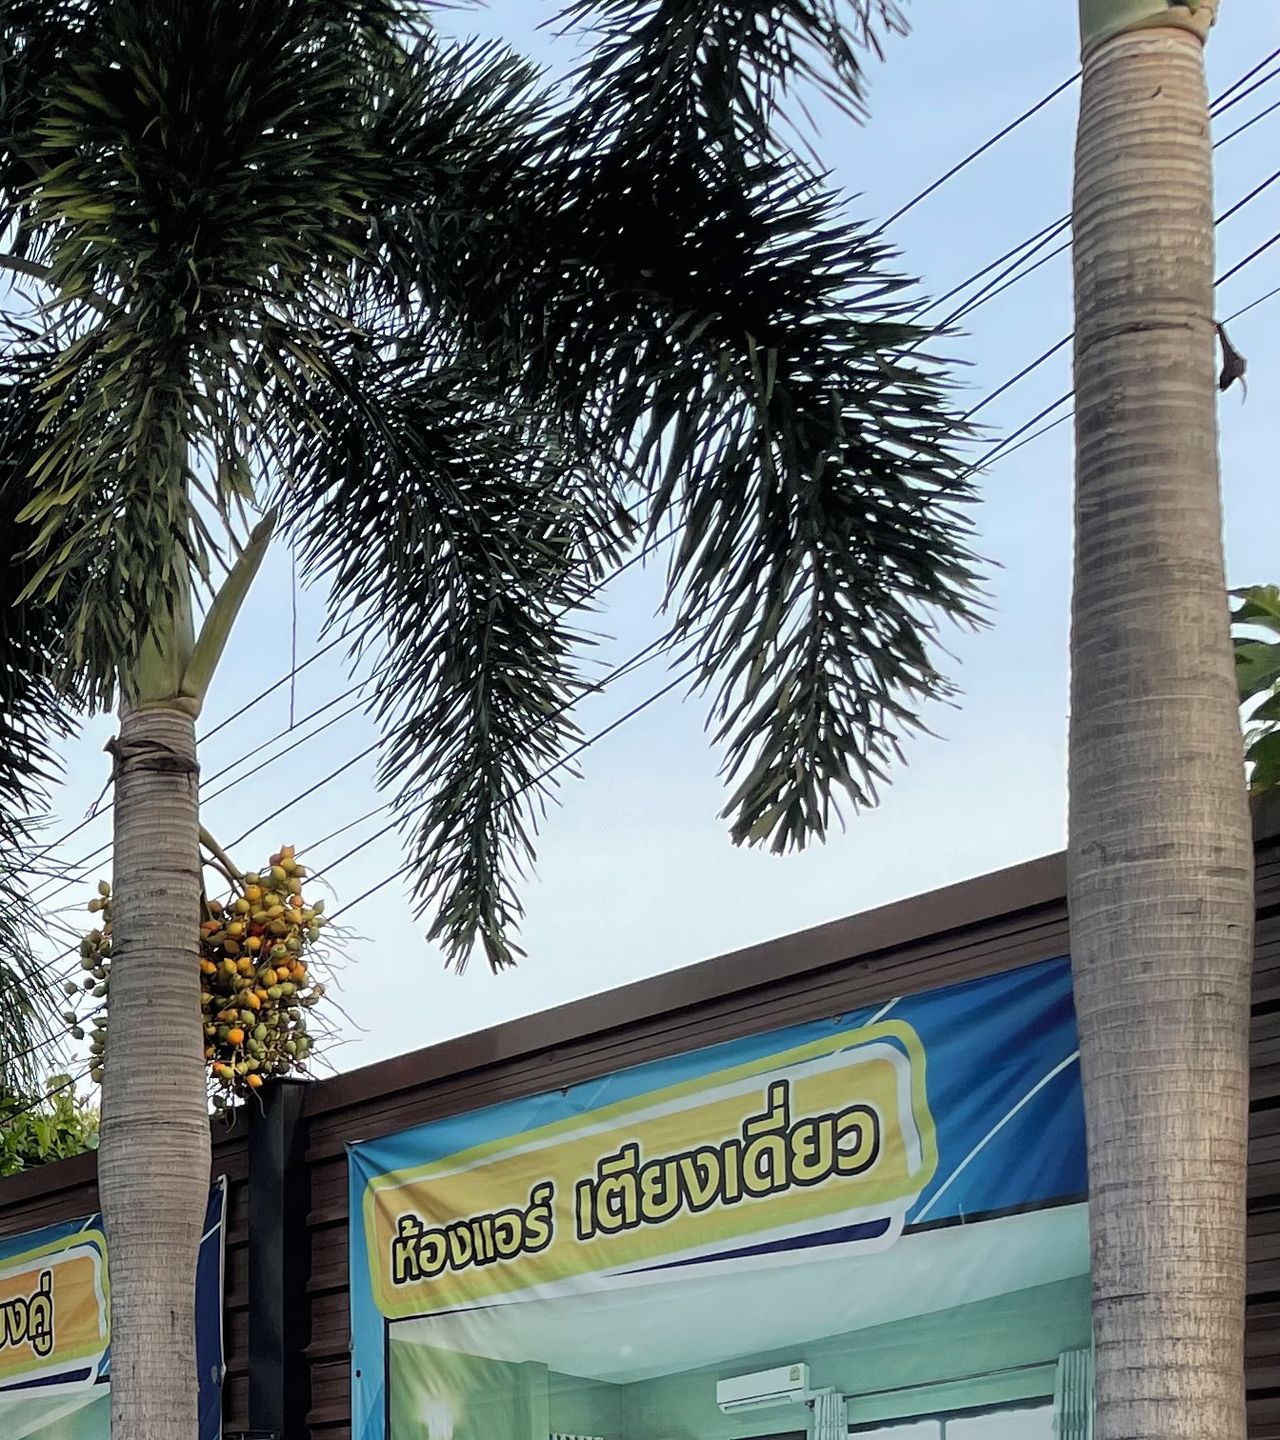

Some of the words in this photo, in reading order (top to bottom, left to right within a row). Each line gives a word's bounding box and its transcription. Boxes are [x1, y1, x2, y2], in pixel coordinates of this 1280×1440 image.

[393, 1181, 553, 1284] ห้องแอร์
[576, 1079, 880, 1241] เตียงเดี่ยว
